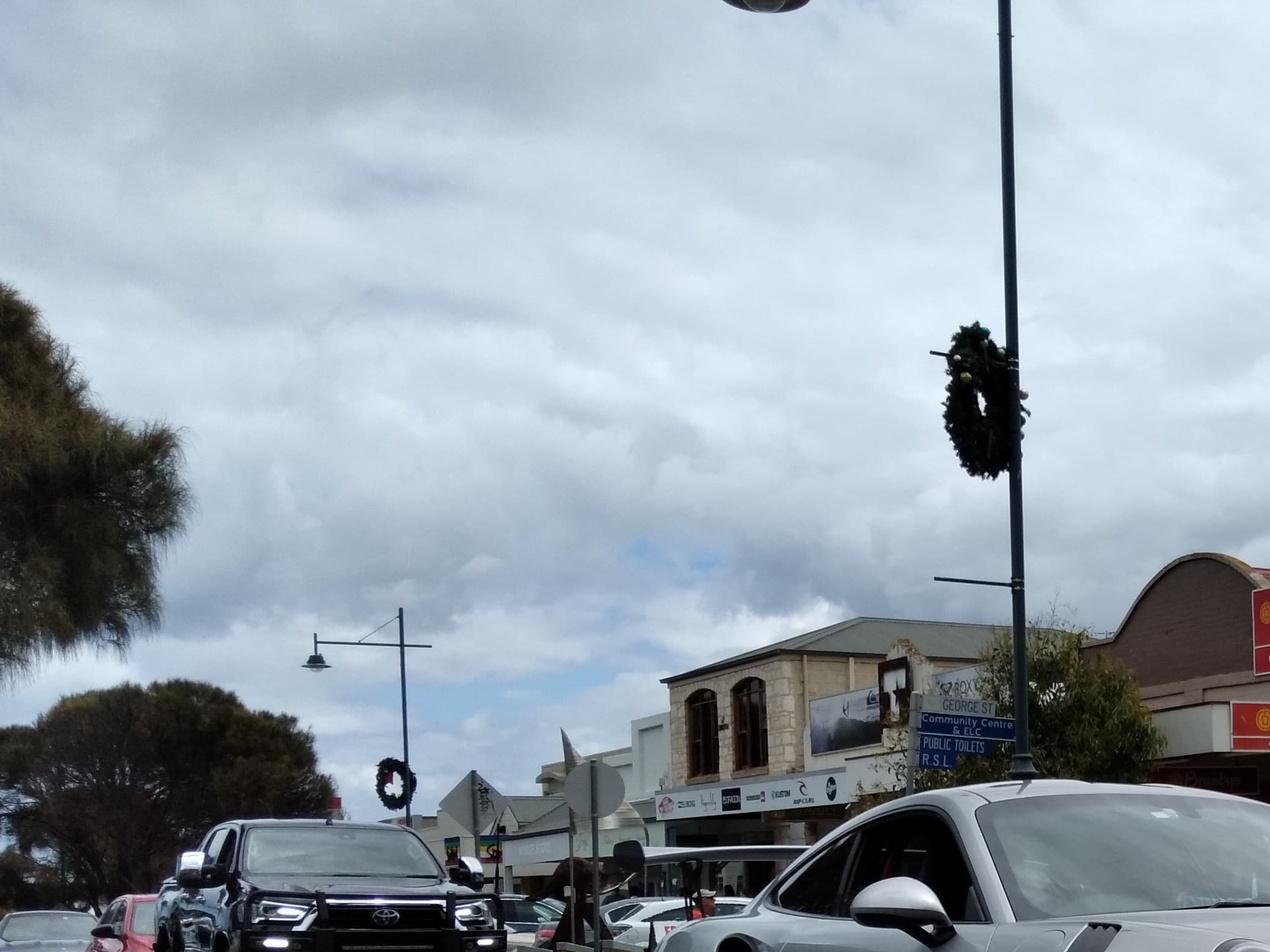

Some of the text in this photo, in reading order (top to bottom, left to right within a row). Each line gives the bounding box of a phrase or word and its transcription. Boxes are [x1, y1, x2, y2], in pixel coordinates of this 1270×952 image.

[943, 699, 994, 715] GEORGE ST
[922, 714, 1013, 729] Community Centre
[952, 726, 982, 736] & ELC
[923, 737, 985, 753] PUBLIC TOILETS
[922, 753, 953, 768] R.S.L.
